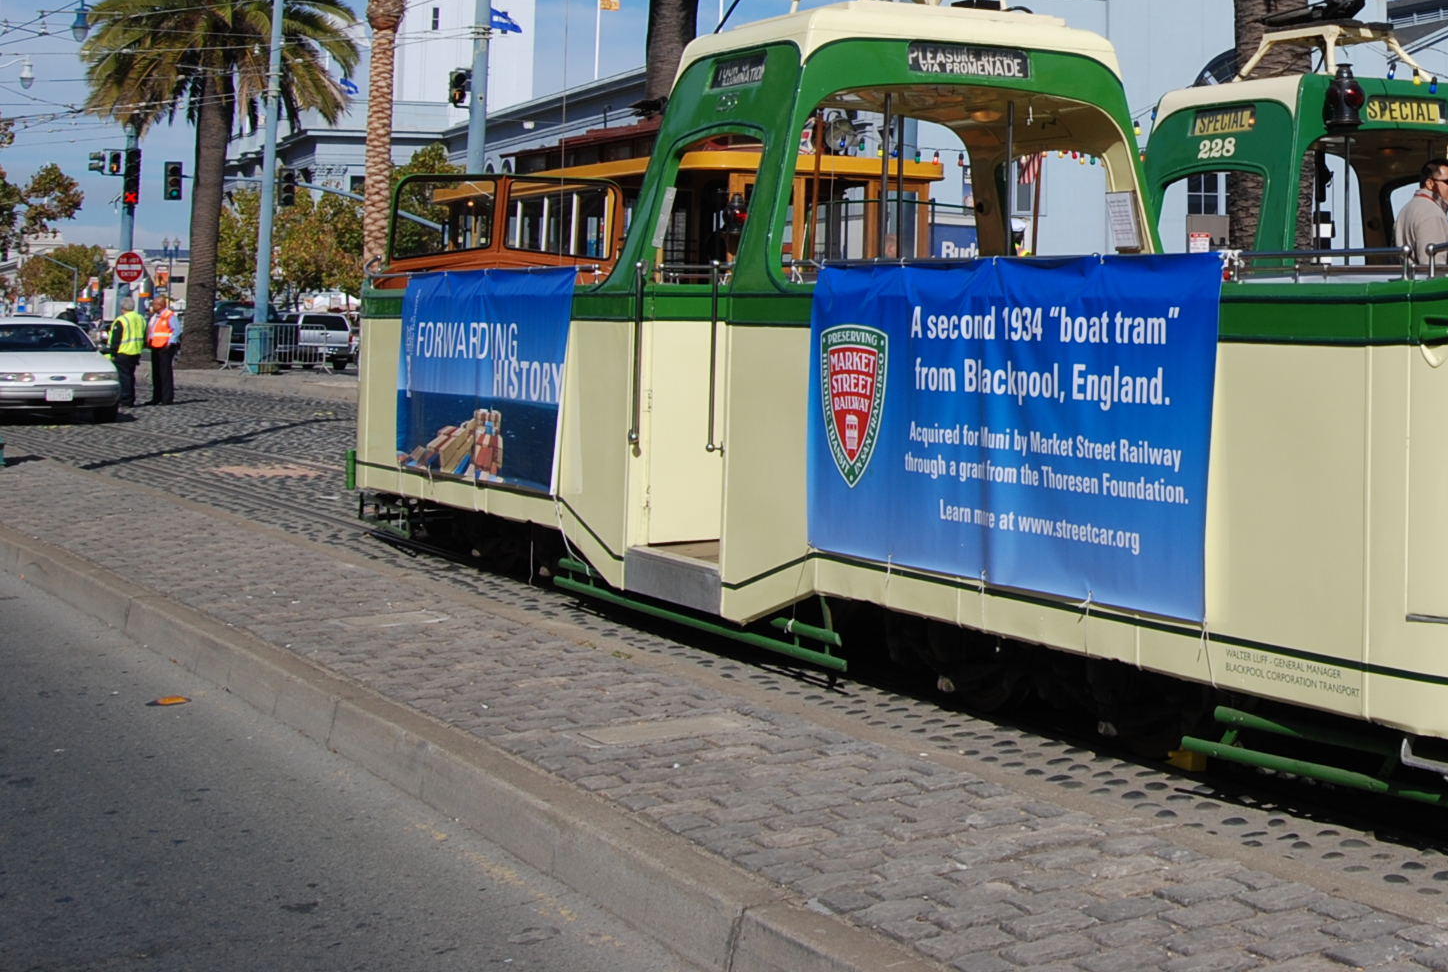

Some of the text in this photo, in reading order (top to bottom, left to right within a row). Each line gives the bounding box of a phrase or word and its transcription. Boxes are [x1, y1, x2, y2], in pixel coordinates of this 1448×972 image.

[908, 47, 976, 64] PLEASURE
[920, 59, 1023, 77] VIA PROMENADE
[1199, 109, 1245, 133] SPECIAL
[1368, 100, 1435, 122] SPECIAL
[1198, 137, 1236, 159] 228
[942, 241, 979, 258] Bud
[828, 330, 878, 346] PRESERVING
[911, 306, 922, 338] A
[927, 306, 995, 340] second
[1002, 307, 1042, 341] 1934
[416, 322, 518, 362] FORWARDING
[830, 351, 876, 374] MARKET
[493, 359, 564, 403] HISTORY
[832, 373, 872, 395] STREET
[915, 357, 1170, 411] from Blackpool, England.
[822, 353, 850, 473] HISTORIC TRANSIT
[834, 395, 870, 413] RAILWAY
[860, 436, 872, 462] SAN
[870, 353, 884, 436] FRANCISCO
[909, 420, 1181, 472] Acquired for Muni by Market Street Railway
[904, 451, 946, 479] through
[949, 460, 956, 476] a
[986, 460, 1017, 484] from
[1020, 464, 1039, 486] the
[1041, 466, 1098, 494] Thoresen
[1102, 473, 1189, 504] Foundation.
[940, 498, 971, 523] Learn
[999, 511, 1014, 531] at
[1018, 515, 1140, 555] www.streetcar.org
[1225, 648, 1251, 662] WALTER
[1252, 654, 1268, 665] LUFF
[1273, 657, 1305, 673] GENERAL
[1306, 664, 1342, 679] MANAGER
[1225, 662, 1360, 698] BLACKPOOL CORPORATION TRANSPORT
